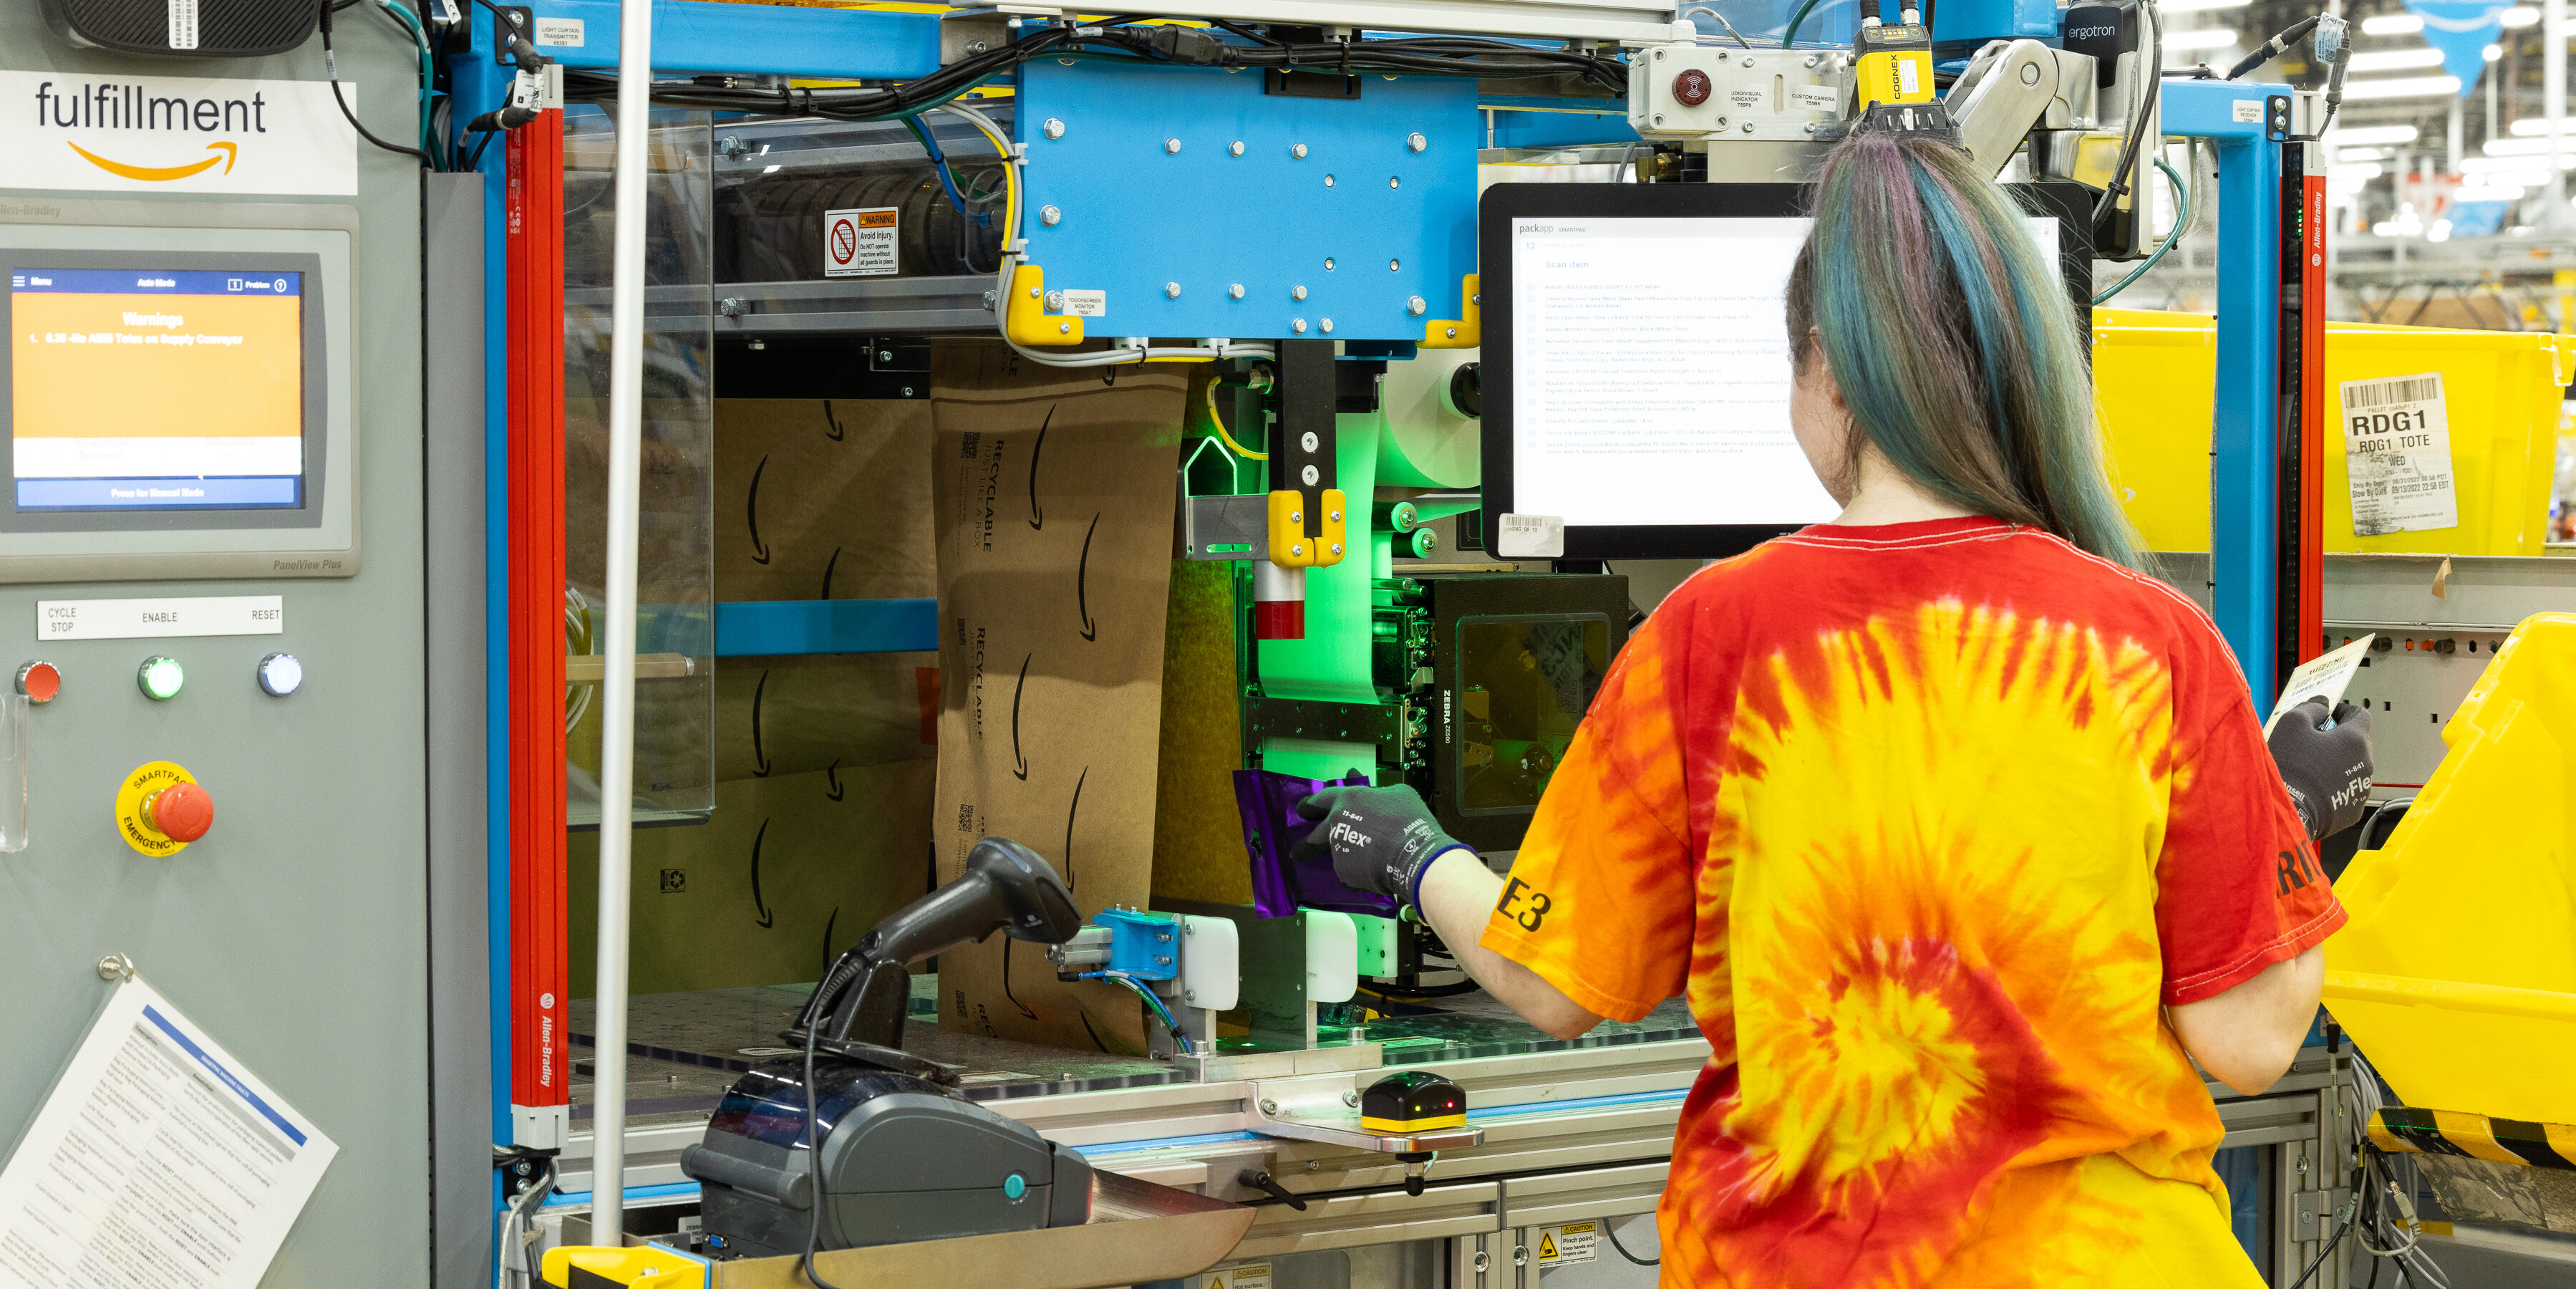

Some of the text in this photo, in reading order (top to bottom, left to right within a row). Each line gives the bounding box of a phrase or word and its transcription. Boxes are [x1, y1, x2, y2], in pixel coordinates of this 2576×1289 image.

[2069, 25, 2115, 40] ergotron
[1891, 54, 1901, 100] COGNEX
[36, 82, 266, 134] fulfillment
[0, 203, 61, 218] llen-Bradley
[866, 214, 895, 224] WARNING
[2313, 191, 2323, 248] Allen-Bradley
[877, 231, 894, 241] injury.
[1519, 224, 1554, 235] packapp
[31, 277, 52, 286] Menu
[137, 278, 175, 288] Auto Mode
[122, 312, 183, 329] Warnings
[160, 333, 194, 347] Supply
[196, 334, 244, 347] Conveyor
[2351, 410, 2426, 436] RDG1
[981, 441, 992, 472] JUST
[2388, 456, 2406, 467] WED
[111, 487, 204, 498] Press for Manual Mode
[977, 478, 987, 504] LIKE
[2439, 481, 2450, 489] EDT
[983, 440, 1005, 553] RECYCLABLE
[974, 521, 982, 549] BOX
[273, 559, 342, 571] PanelView Plus
[48, 607, 280, 624] CYCLE ENABLE RESET
[51, 621, 74, 632] STOP
[976, 628, 986, 742] RECYCLABLE
[2345, 761, 2365, 777] 11-841
[2331, 776, 2372, 811] HyFle
[1342, 810, 1363, 822] 11-841
[124, 816, 177, 849] EMERGENCY
[1497, 877, 1551, 932] E3
[541, 1015, 552, 1088] Allen-Bradley
